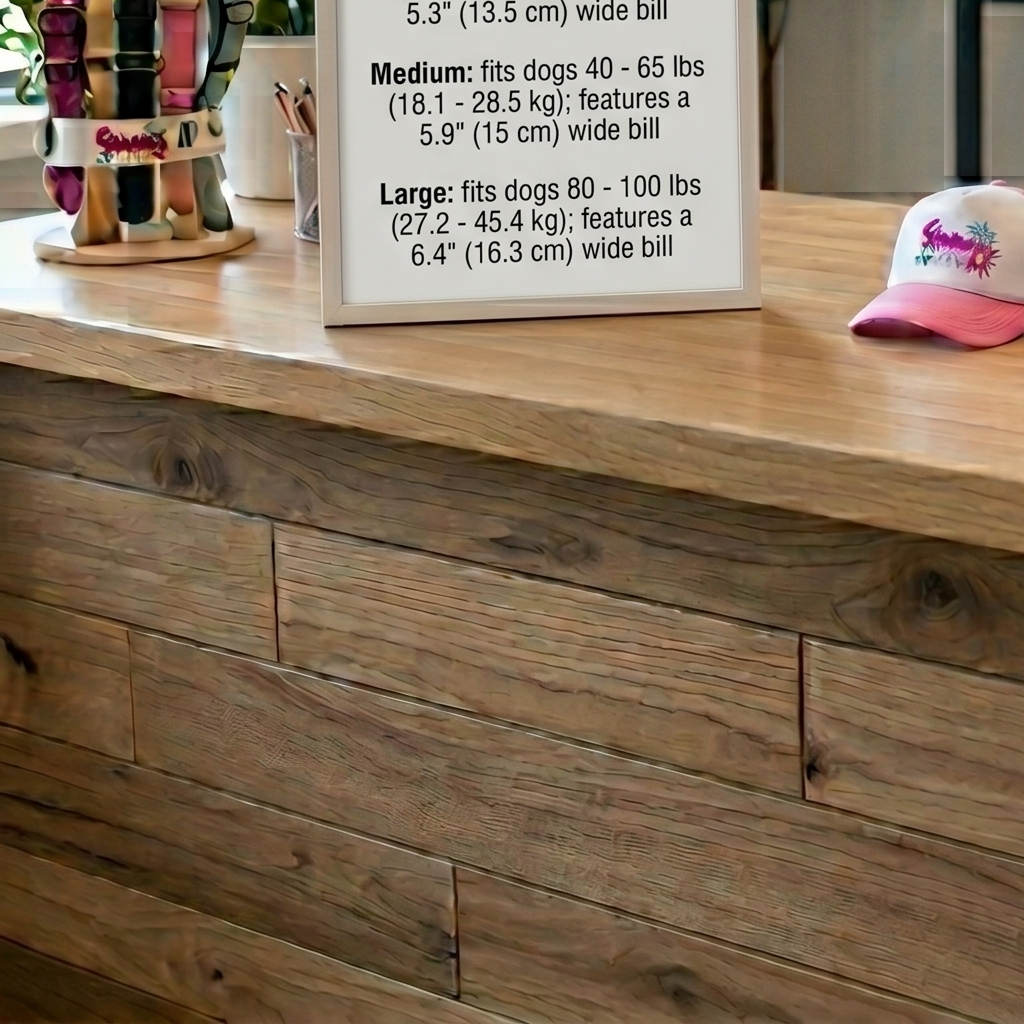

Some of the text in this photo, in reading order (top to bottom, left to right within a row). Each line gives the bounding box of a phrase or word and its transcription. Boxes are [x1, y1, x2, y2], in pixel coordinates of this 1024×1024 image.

[406, 0, 450, 25] 5.3"
[459, 0, 517, 29] (13.5
[370, 60, 472, 85] Medium:
[479, 59, 515, 82] fits
[523, 58, 577, 86] dogs
[585, 56, 613, 79] 40
[637, 55, 664, 78] 65
[673, 54, 704, 77] lbs
[388, 91, 442, 121] (18.1
[472, 89, 521, 113] 28.5
[529, 87, 570, 117] kg);
[578, 87, 669, 110] features
[677, 90, 690, 108] a
[419, 116, 659, 150] 5.9" (15 cm) wide bill
[380, 182, 453, 209] Large:
[460, 179, 496, 202] fits
[504, 178, 559, 206] dogs
[567, 176, 594, 199] 80
[620, 174, 660, 197] 100
[669, 173, 701, 196] lbs
[391, 211, 449, 242] (27.2
[473, 208, 523, 232] 45.4
[531, 207, 573, 236] kg);
[580, 206, 672, 229] features
[679, 208, 692, 226] a
[411, 233, 672, 270] 6.4" (16.3 cm) wide bill
